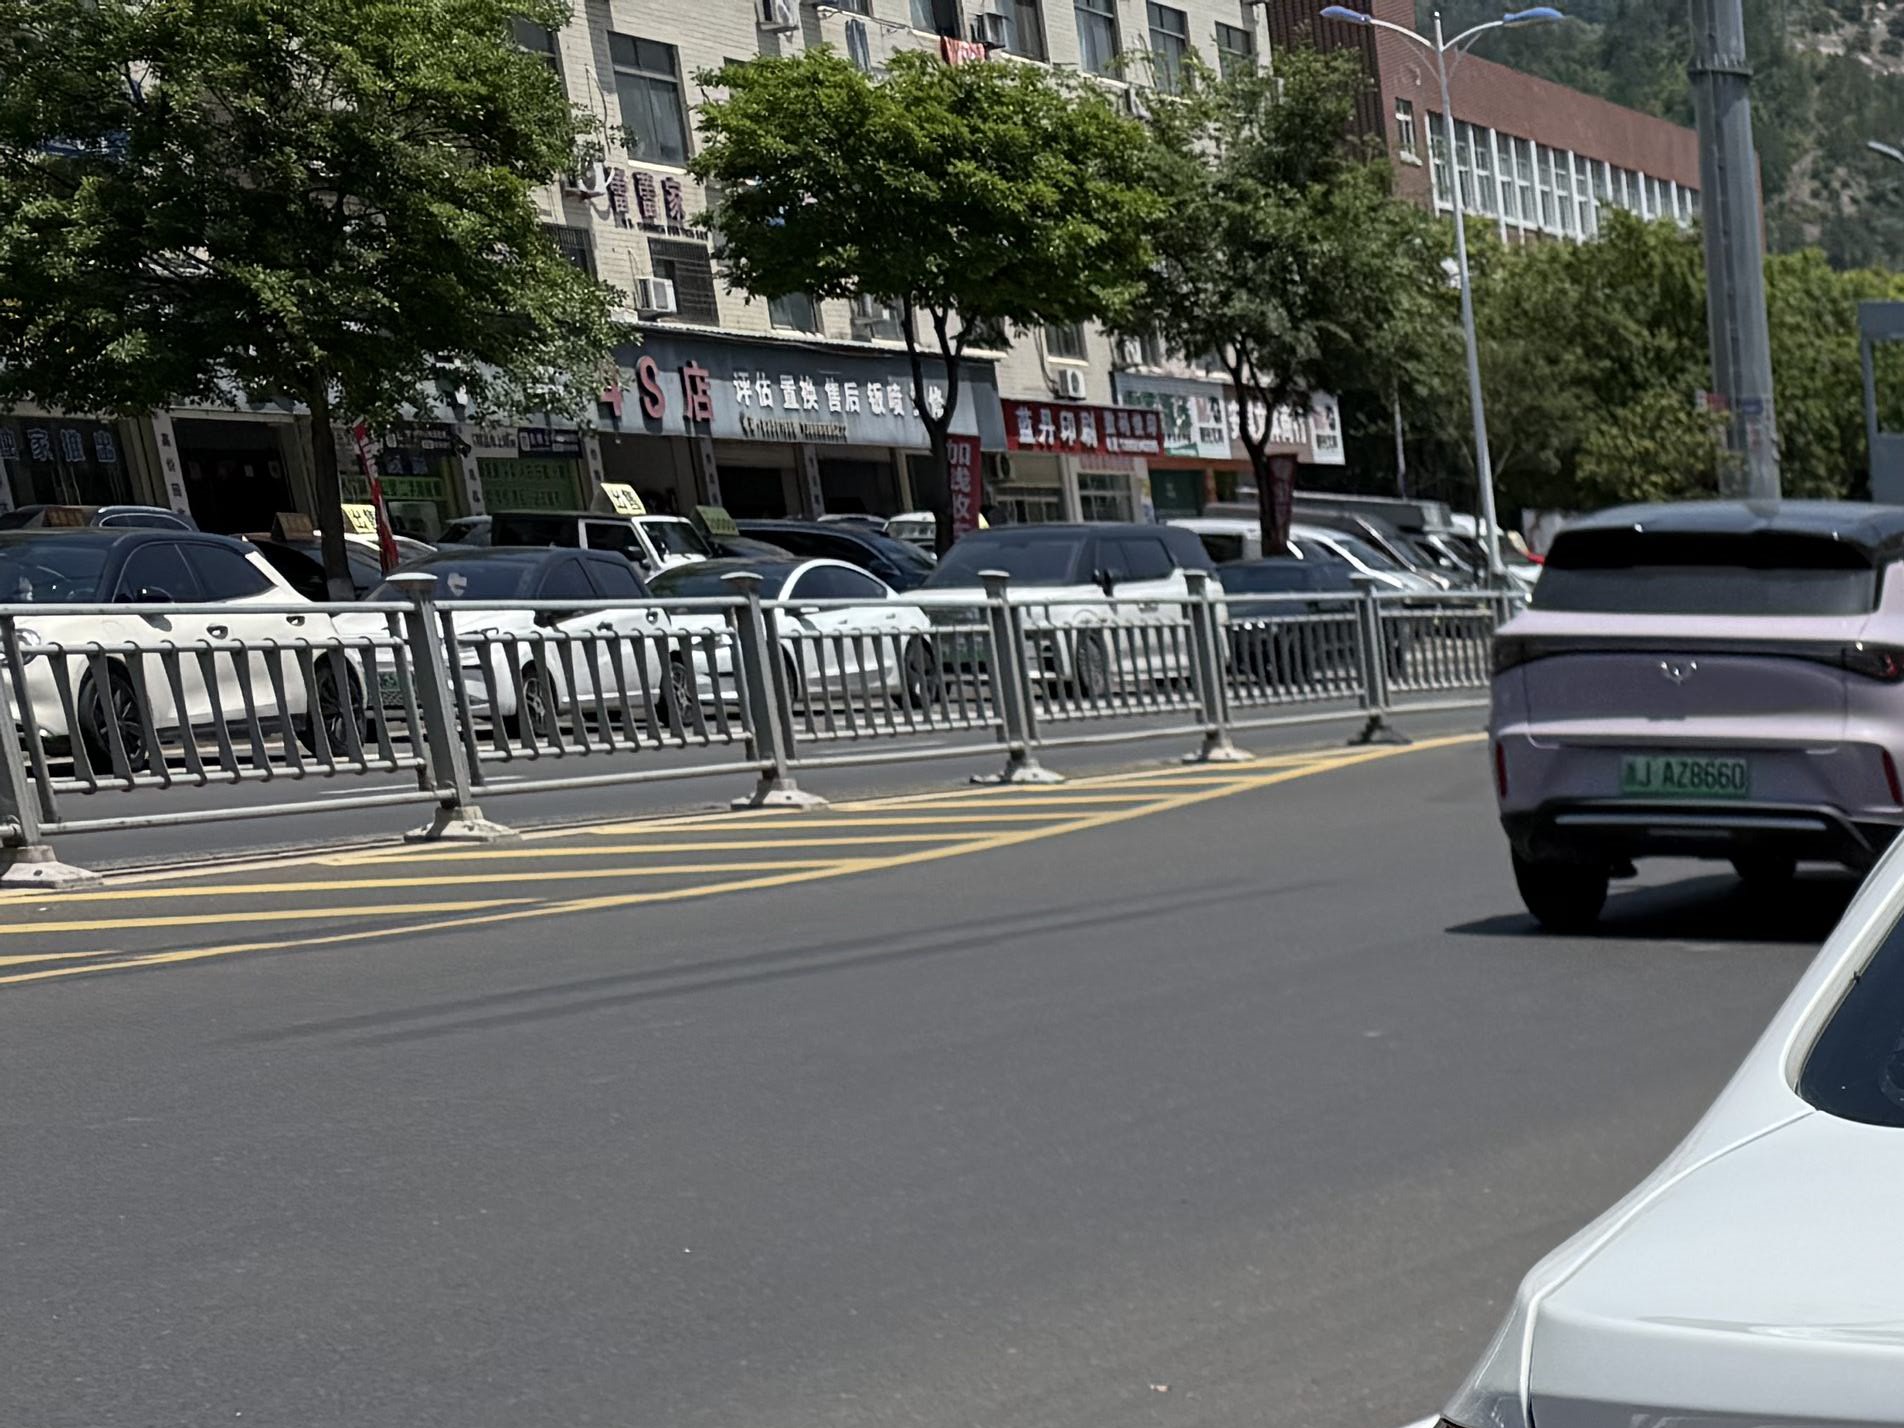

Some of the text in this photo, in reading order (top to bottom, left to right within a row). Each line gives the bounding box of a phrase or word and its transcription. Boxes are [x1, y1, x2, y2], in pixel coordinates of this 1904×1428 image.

[733, 371, 774, 408] 评估
[780, 375, 819, 411] 置换
[825, 377, 860, 414] 售后
